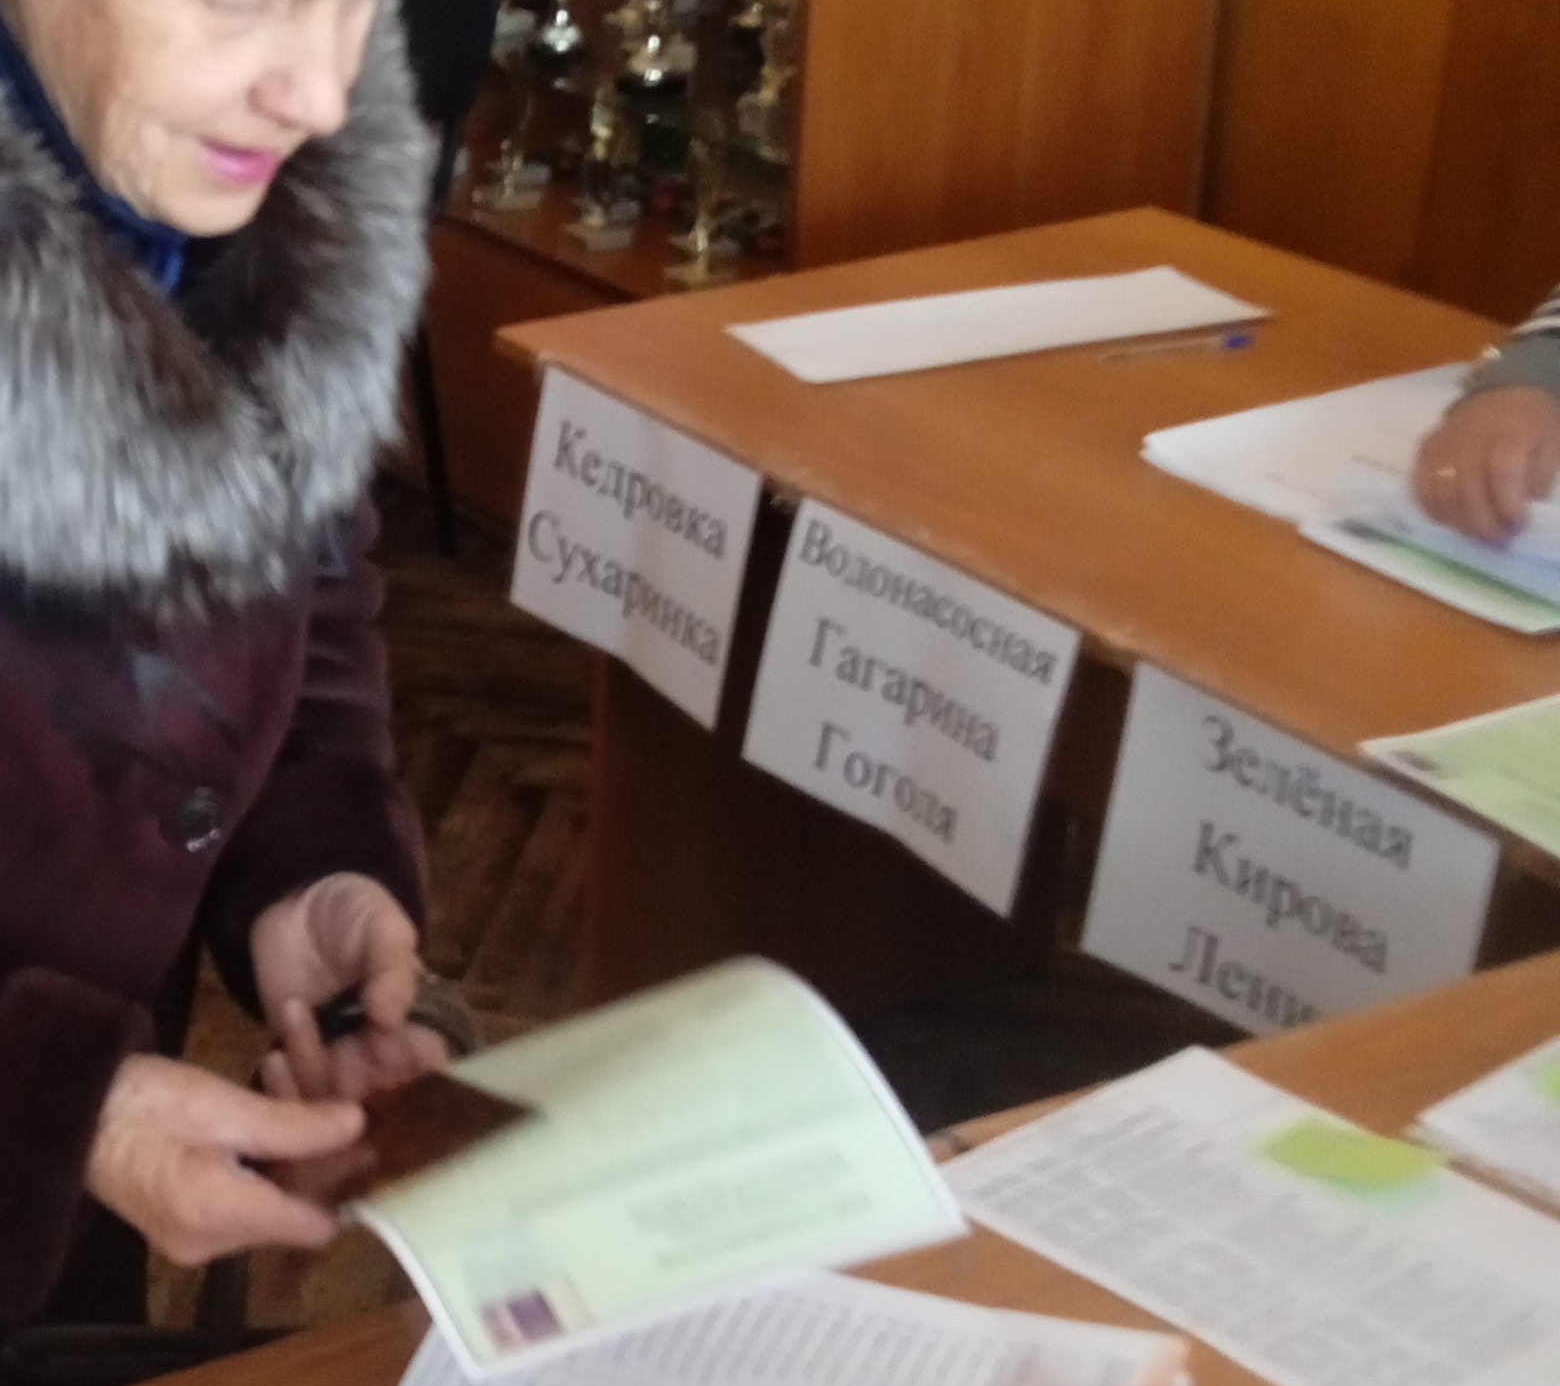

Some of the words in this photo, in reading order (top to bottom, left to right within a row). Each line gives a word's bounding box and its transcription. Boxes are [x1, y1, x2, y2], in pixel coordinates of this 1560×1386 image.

[554, 419, 728, 560] Кедровка
[528, 510, 722, 665] Сухаринка
[798, 518, 1058, 687] Водонасосная
[809, 617, 999, 762] Гагарина
[813, 720, 960, 844] Гоголя
[1201, 714, 1414, 871] Зелёная
[1193, 819, 1387, 968] Кирова
[1168, 925, 1322, 1029] Лени
